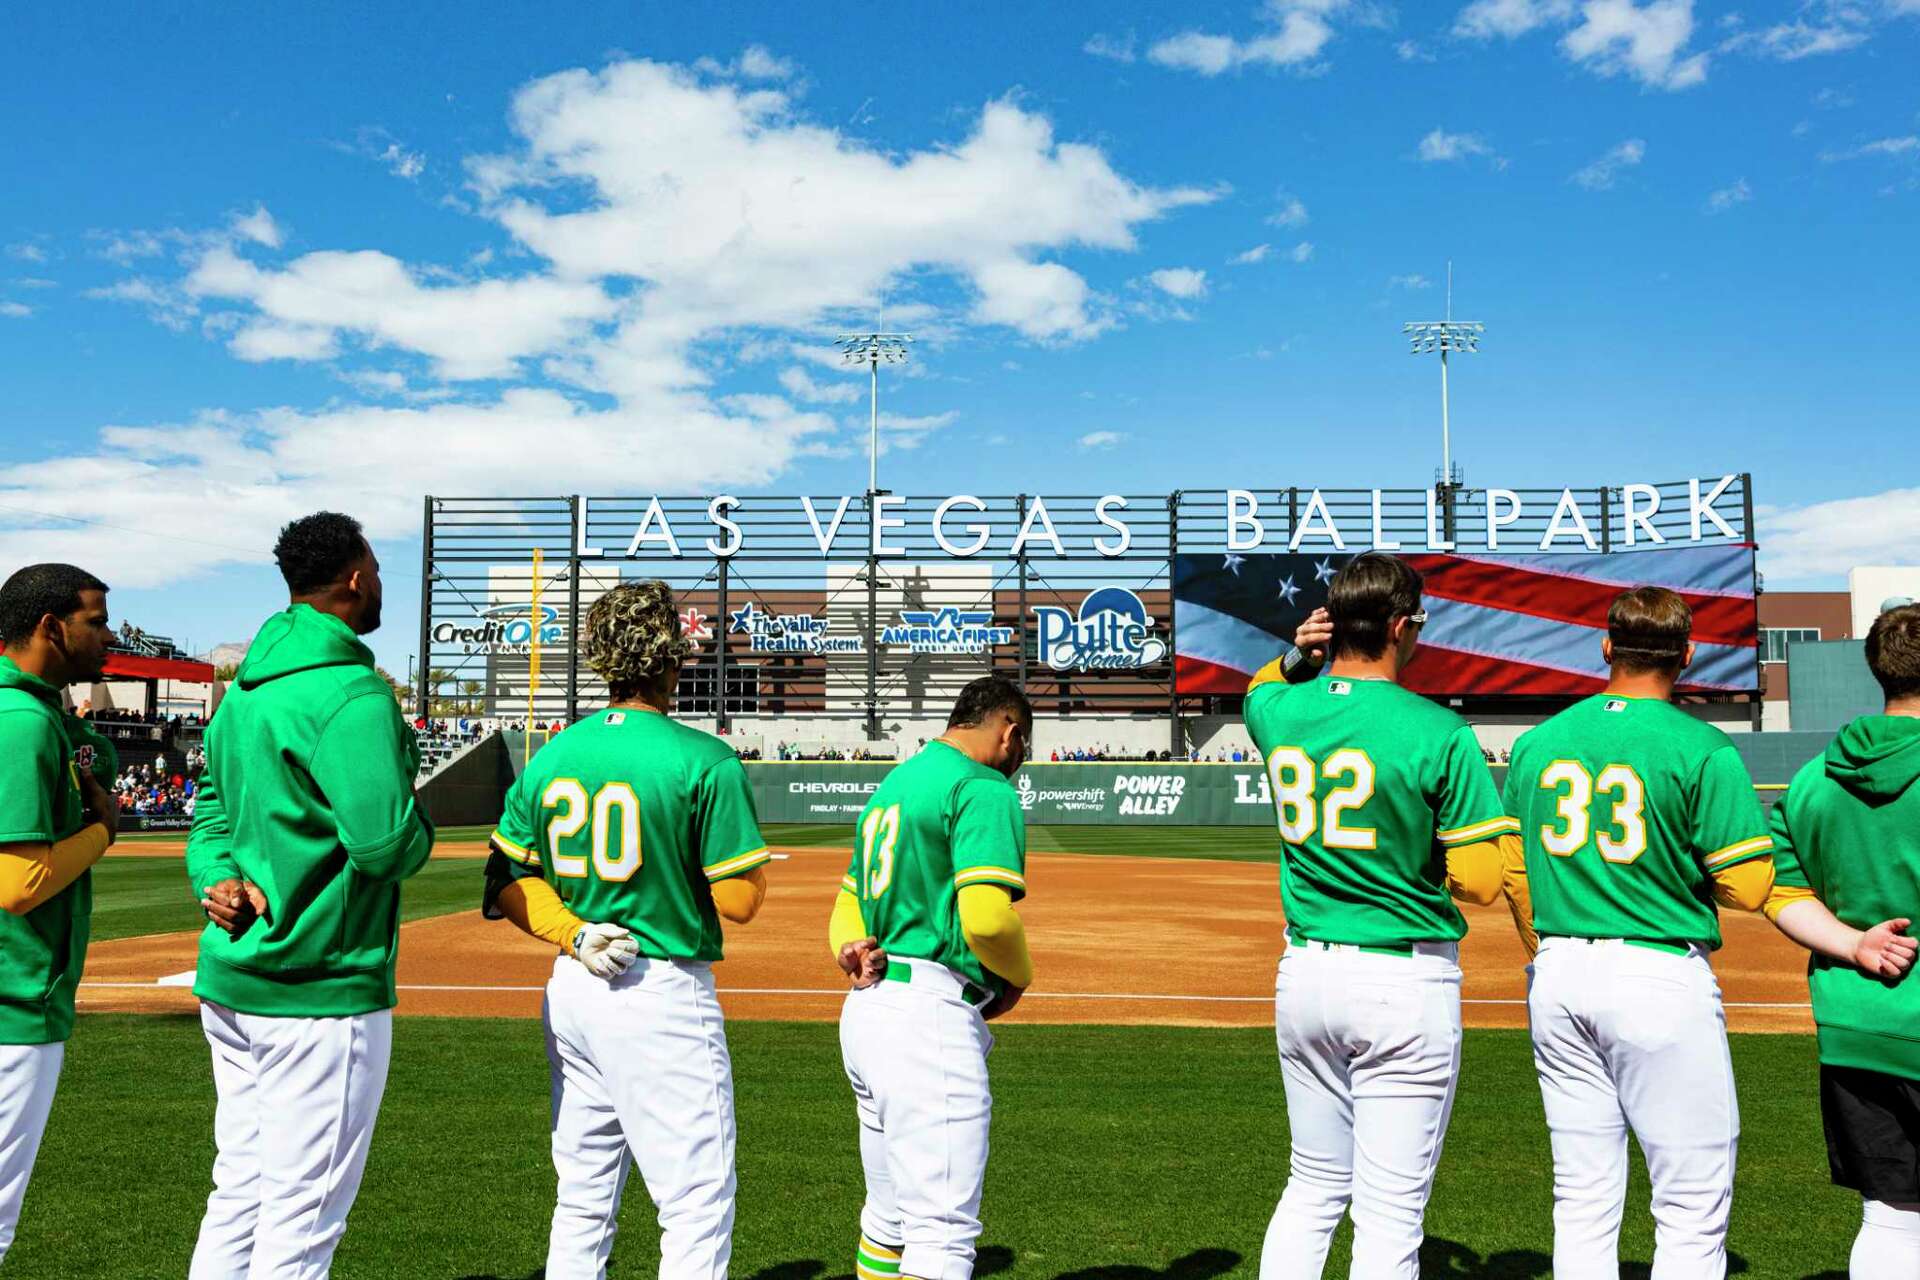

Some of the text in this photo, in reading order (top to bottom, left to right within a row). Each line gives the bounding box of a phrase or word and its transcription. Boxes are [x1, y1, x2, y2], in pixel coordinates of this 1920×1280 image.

[577, 473, 1744, 558] LAS VEGAS BALLPARK
[752, 614, 828, 636] The Valley
[881, 628, 1012, 644] AMERICA FIRST
[1032, 607, 1146, 663] Pulte
[752, 636, 860, 655] Health System
[1055, 642, 1163, 672] Homes
[1038, 787, 1105, 803] powershift
[1113, 775, 1186, 795] POWER
[1267, 745, 1376, 851] 82
[1119, 795, 1181, 815] ALLEY
[1539, 759, 1647, 864] 33
[542, 778, 643, 882] 20
[860, 804, 900, 900] 13
